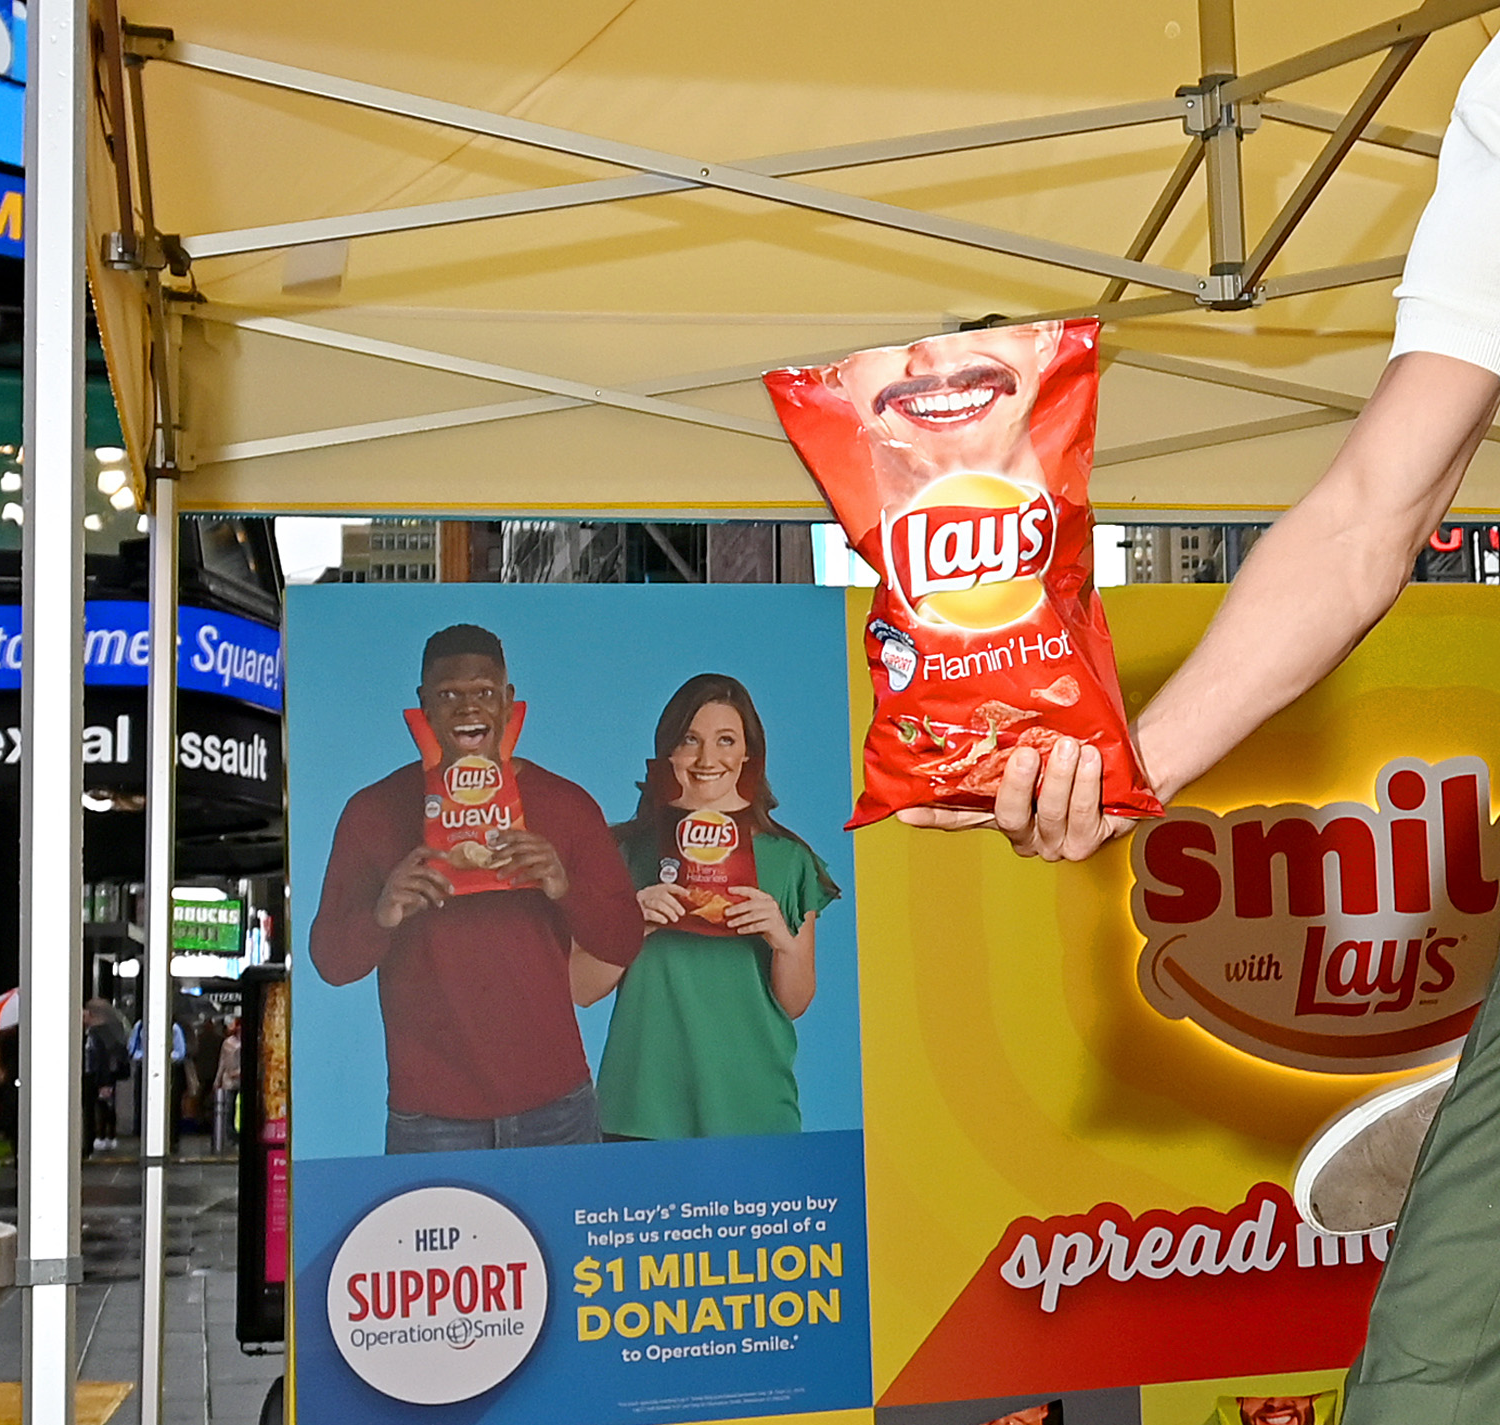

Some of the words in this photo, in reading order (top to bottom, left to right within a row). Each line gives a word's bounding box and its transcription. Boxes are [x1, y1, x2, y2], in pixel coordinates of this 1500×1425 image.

[906, 502, 1048, 598] Lay's
[192, 624, 284, 690] Square!
[923, 638, 1015, 681] Flamin'
[1019, 629, 1074, 664] Hot
[175, 732, 268, 780] ssault
[451, 766, 496, 791] Lay's
[442, 804, 511, 830] wavy
[682, 820, 733, 848] Lay's
[1224, 953, 1282, 983] with
[1295, 926, 1458, 1017] Lay's
[574, 1208, 619, 1225] Each
[681, 1201, 729, 1219] Smile
[734, 1200, 767, 1217] bag
[771, 1198, 802, 1216] you
[806, 1196, 838, 1213] buy
[588, 1230, 635, 1248] helps
[639, 1231, 659, 1243] us
[664, 1224, 713, 1241] reach
[717, 1225, 746, 1237] our
[751, 1219, 788, 1239] goal
[792, 1217, 811, 1232] of
[815, 1219, 826, 1231] a
[415, 1227, 460, 1252] HELP
[1001, 1200, 1285, 1313] spread
[347, 1262, 527, 1322] SUPPORT
[573, 1256, 624, 1298] $1
[639, 1242, 843, 1291] MILLION
[350, 1324, 444, 1351] Operation
[473, 1317, 524, 1338] Smile
[577, 1288, 841, 1341] DONATION
[622, 1348, 641, 1362] to
[646, 1340, 737, 1363] Operation
